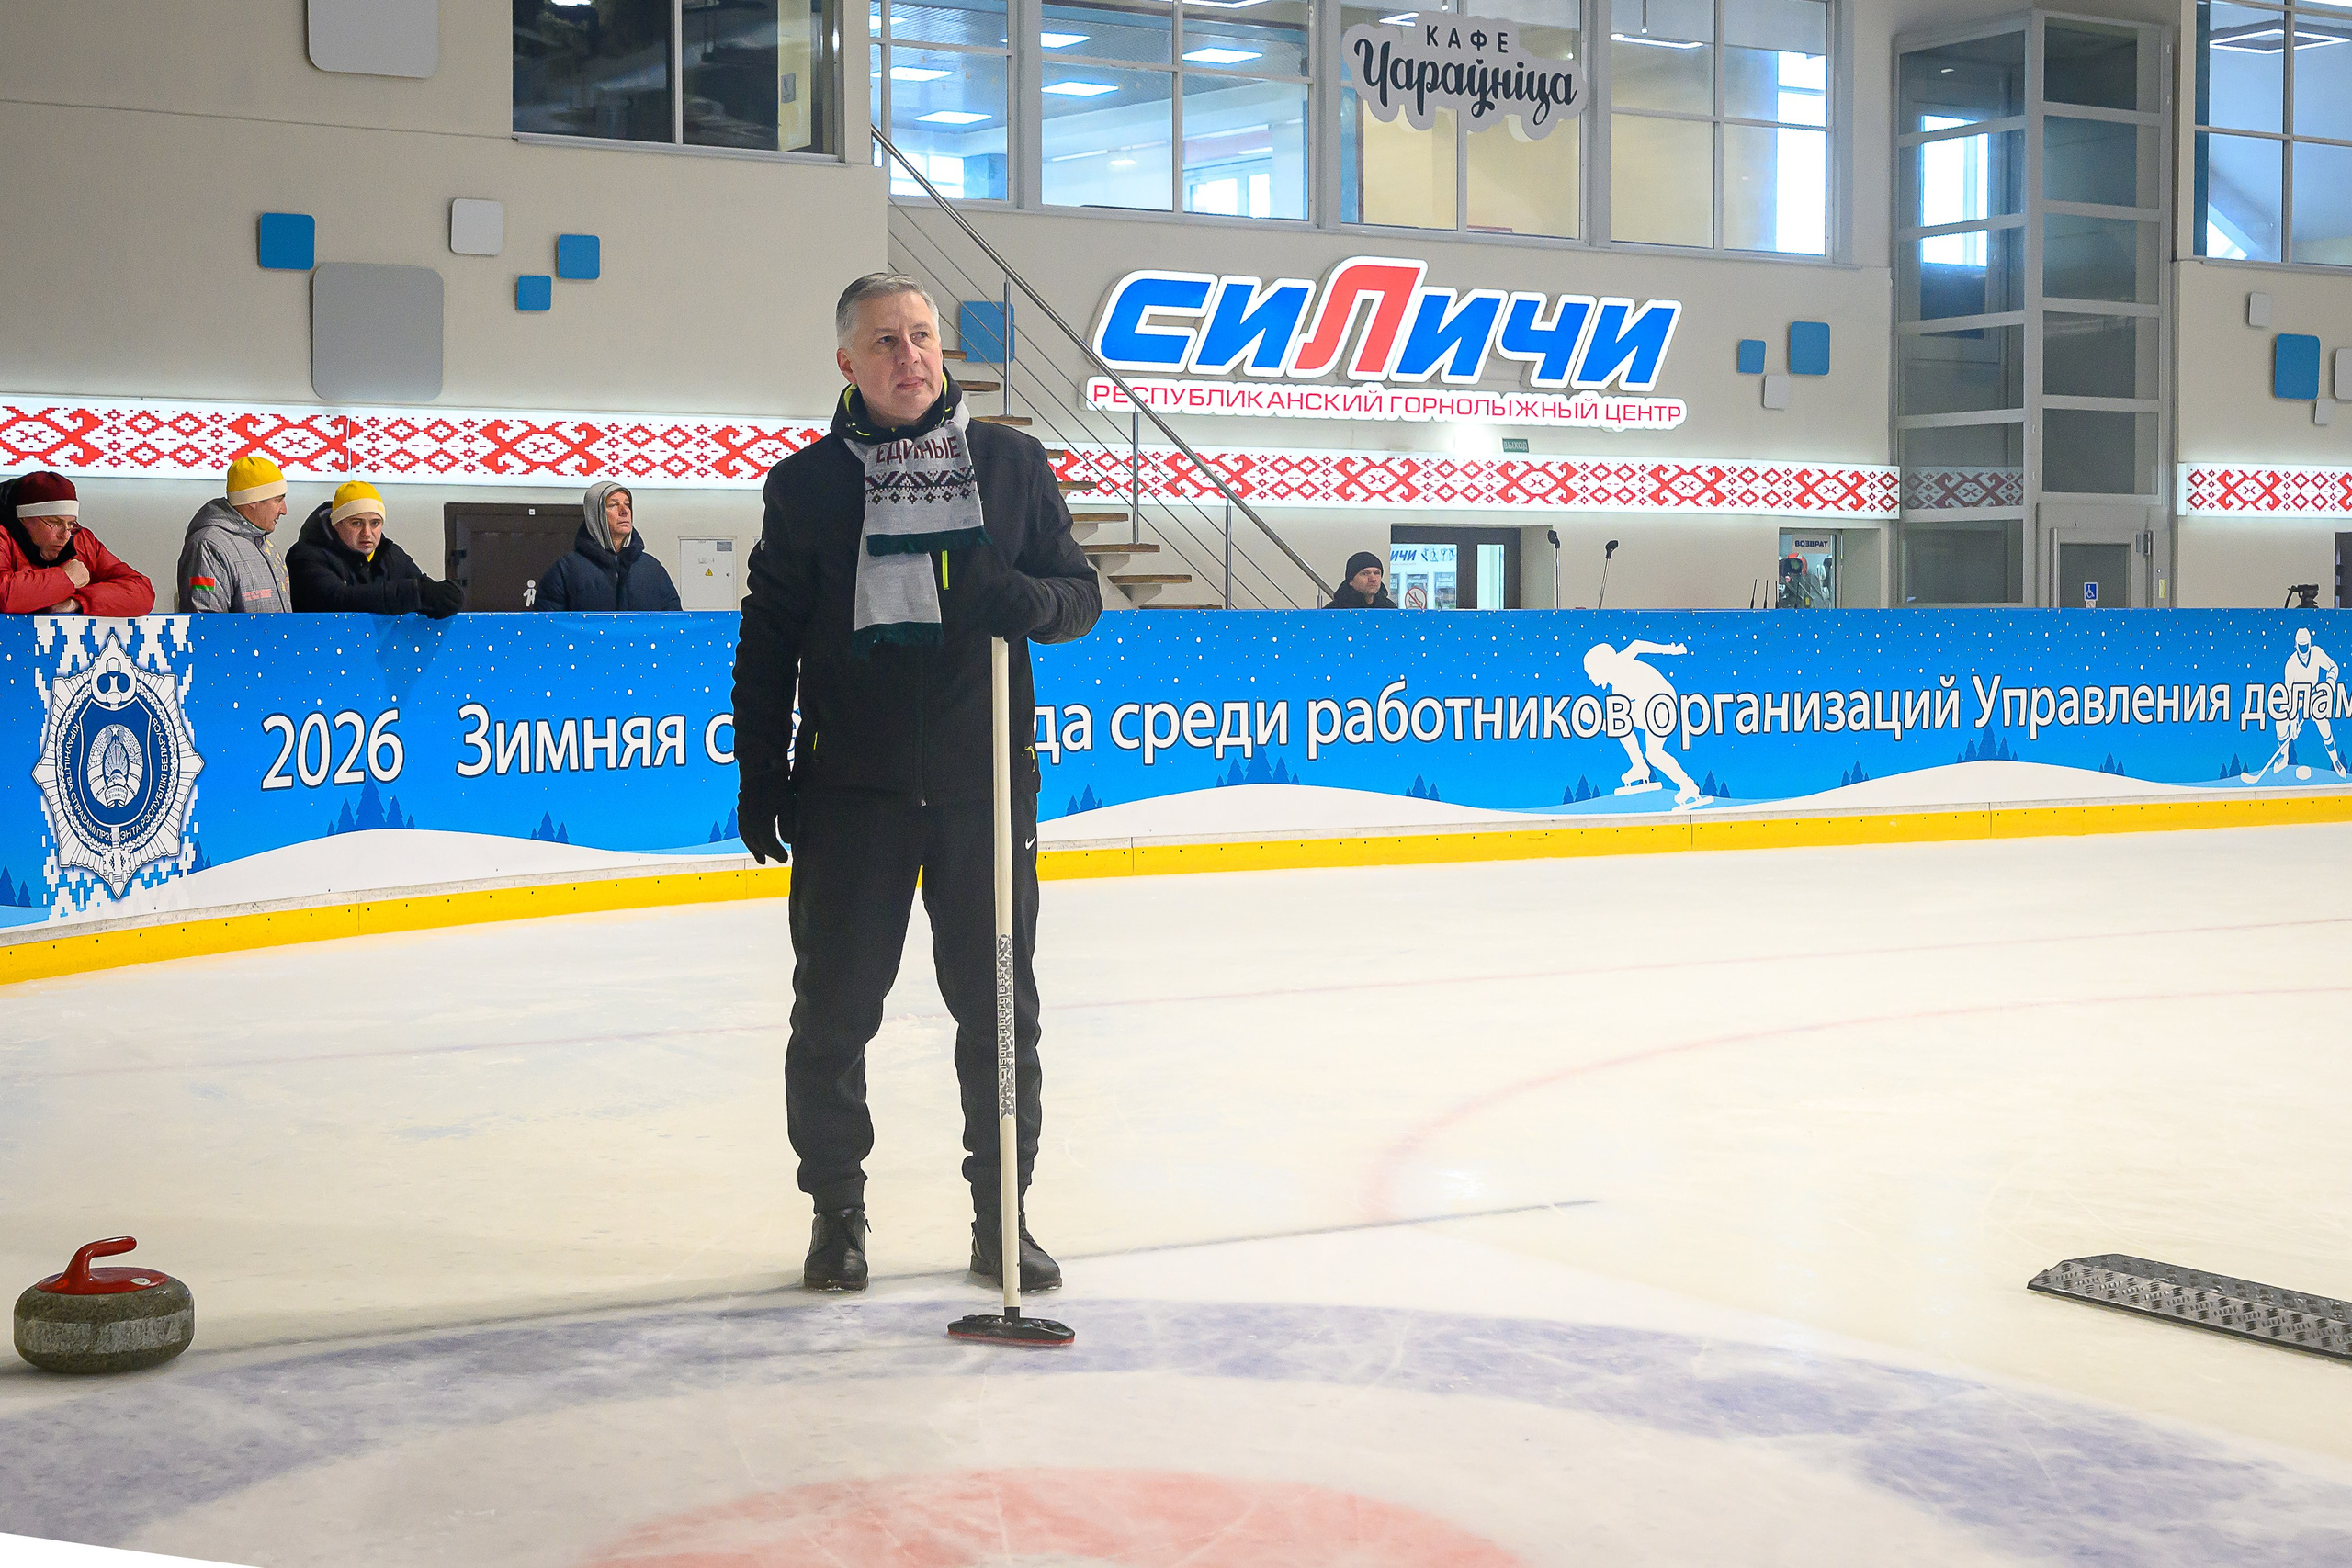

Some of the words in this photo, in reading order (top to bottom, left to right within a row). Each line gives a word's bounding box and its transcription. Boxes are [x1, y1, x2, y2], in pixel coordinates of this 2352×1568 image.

[1426, 24, 1509, 53] КАФЕ
[1354, 39, 1577, 126] Чараўніца
[1093, 384, 1383, 412] РЕСПУБЛИКАНСКИЙ
[1390, 396, 1598, 420] ГОРНОЛЫЖНЫЙ
[1606, 404, 1681, 424] ЦЕНТР
[876, 436, 961, 465] ЕДИНЫЕ
[1390, 549, 1417, 562] ИЧИ
[1110, 700, 1288, 765] среди
[1306, 679, 1634, 761] работников
[1645, 674, 1961, 750] организаций
[1972, 674, 2230, 740] Управления
[261, 707, 405, 791] 2026
[456, 702, 687, 776] Зимняя
[96, 824, 142, 841] ПРЭЭНТА
